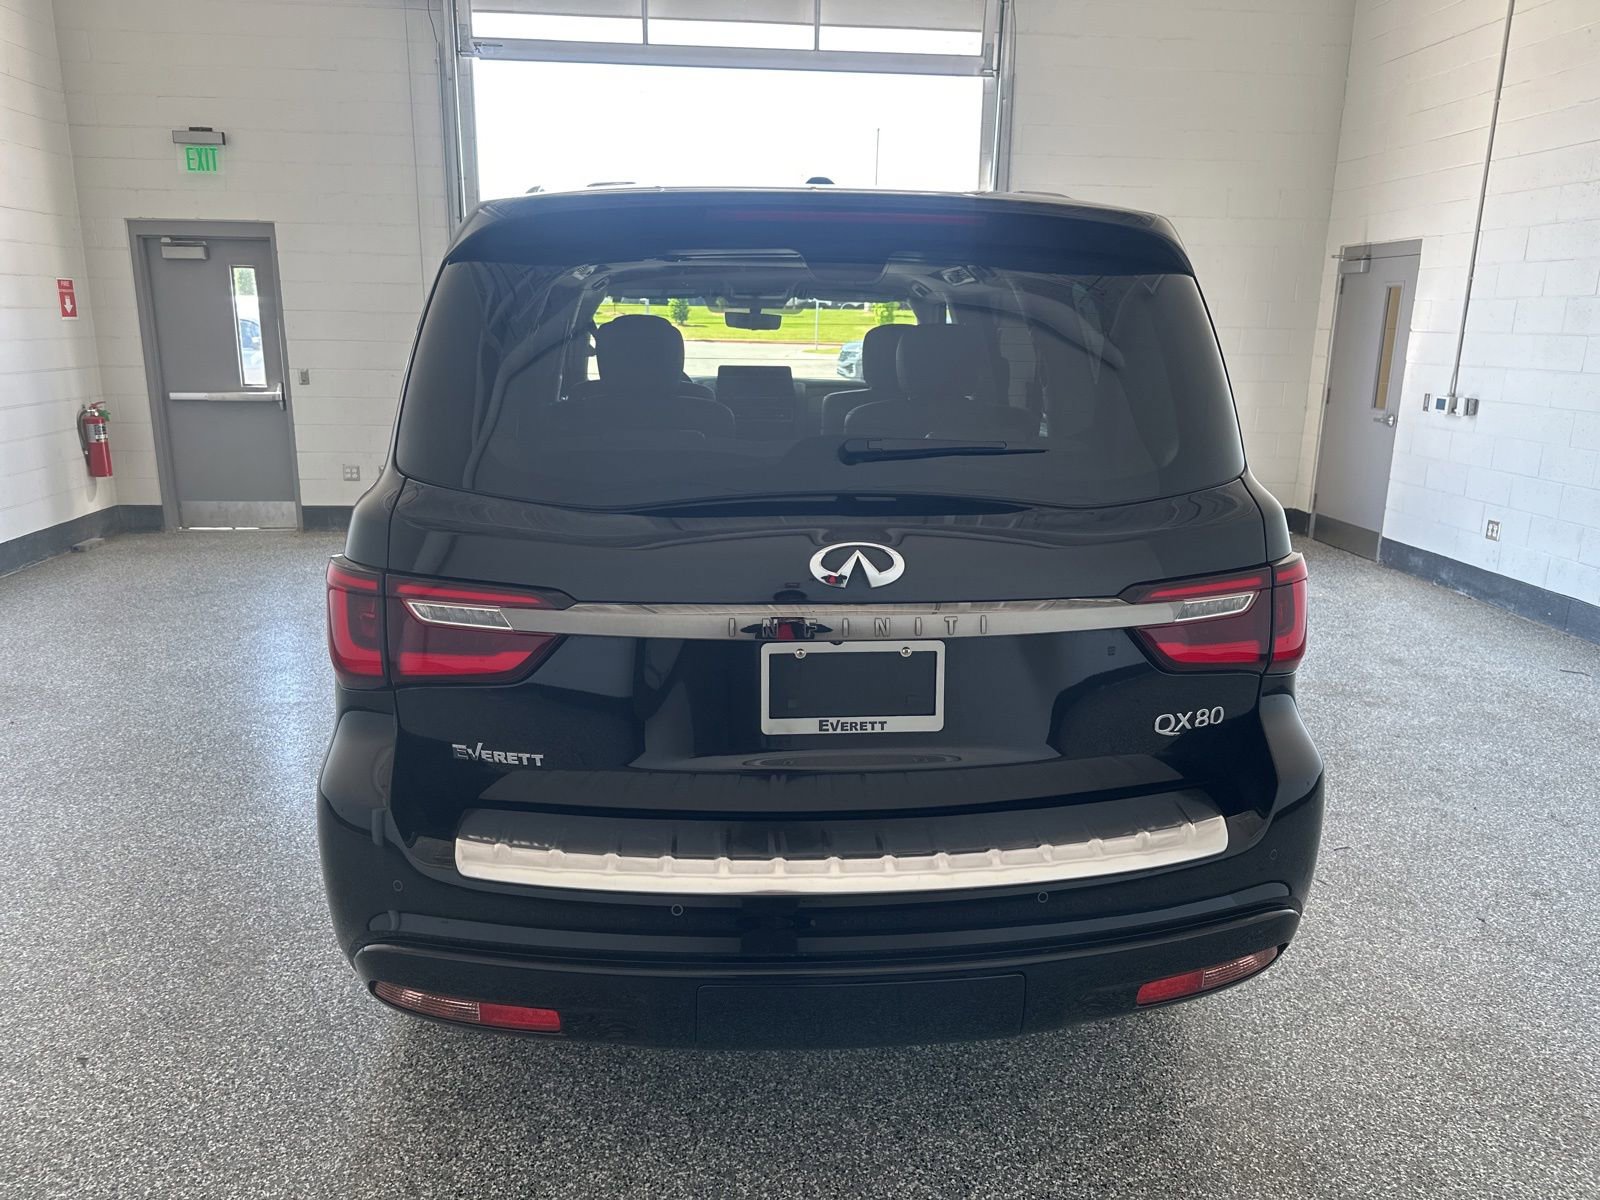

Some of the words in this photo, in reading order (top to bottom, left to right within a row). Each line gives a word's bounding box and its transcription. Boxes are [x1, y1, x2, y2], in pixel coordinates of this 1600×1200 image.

[186, 147, 217, 171] EXIT
[728, 615, 987, 638] INFINITI
[818, 719, 887, 732] EVERETT
[1154, 706, 1225, 736] QX80
[451, 742, 544, 766] EVERETT
